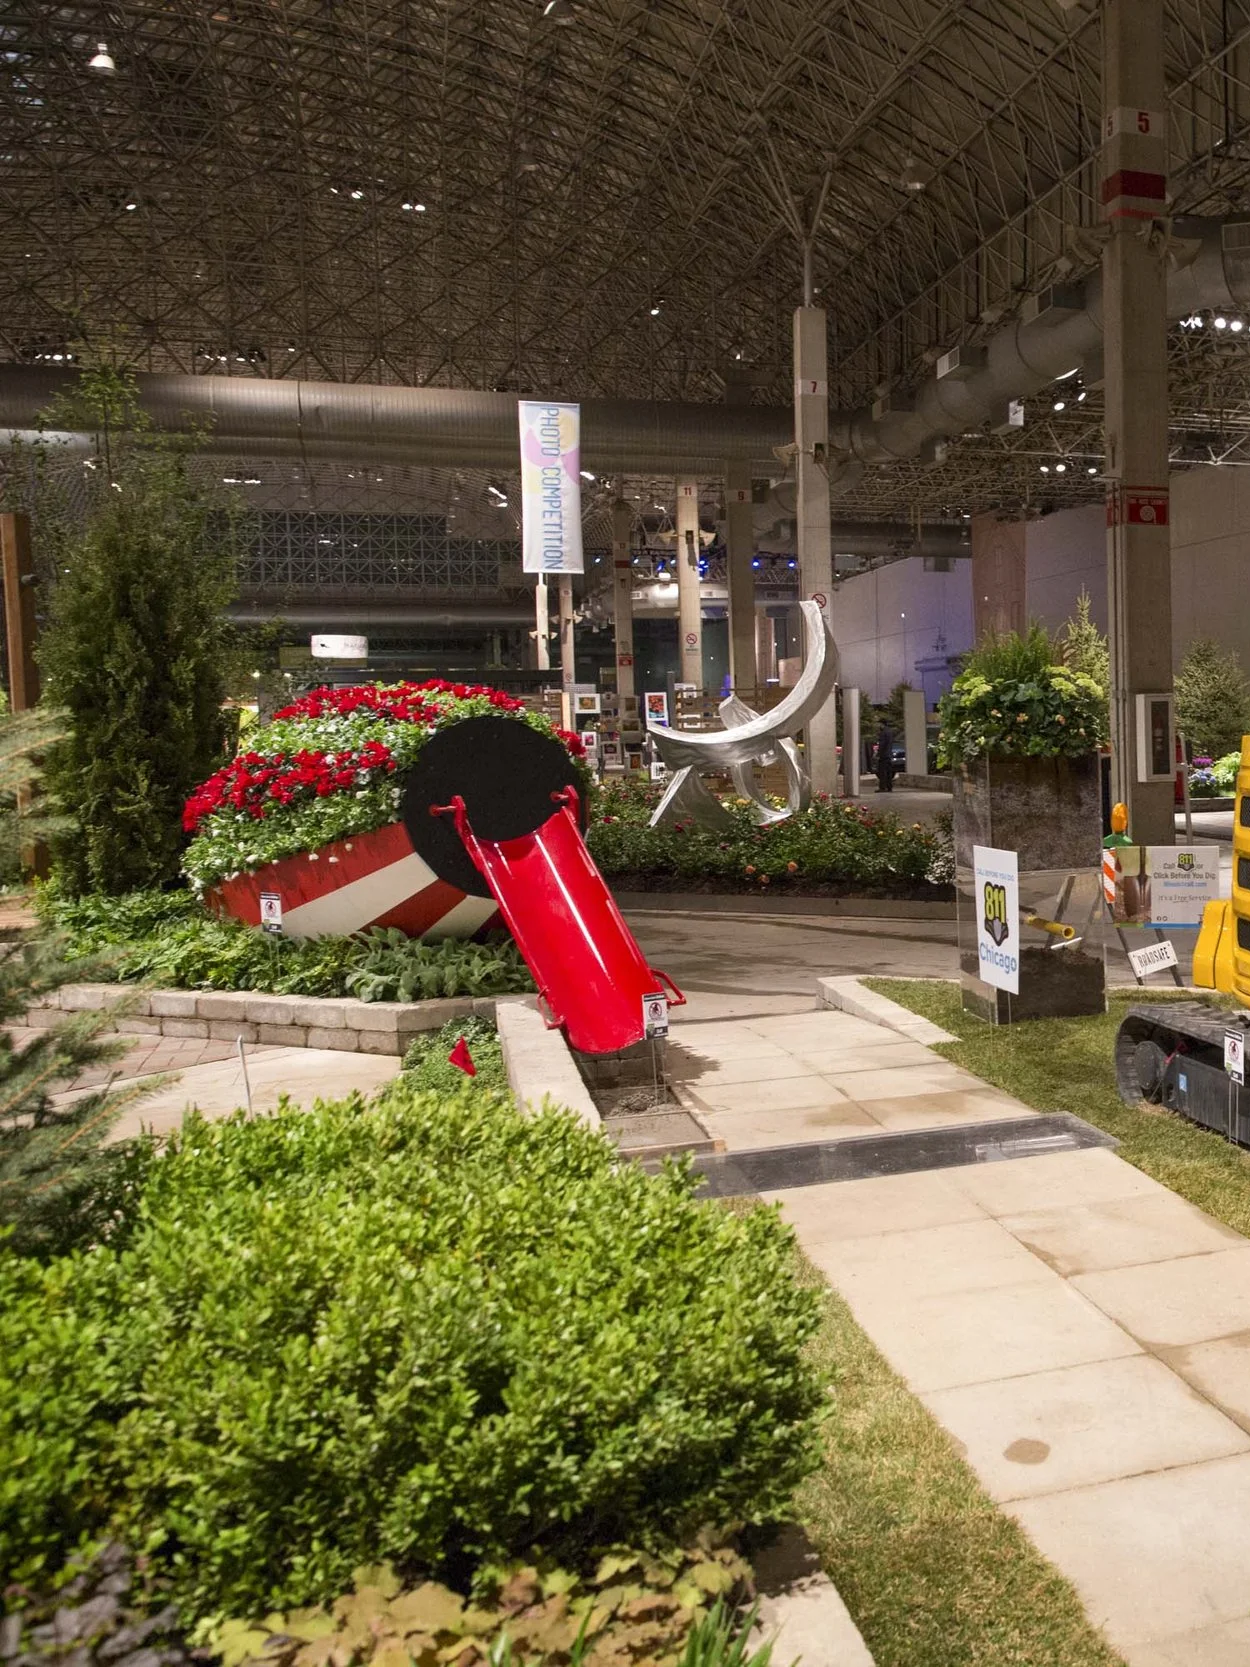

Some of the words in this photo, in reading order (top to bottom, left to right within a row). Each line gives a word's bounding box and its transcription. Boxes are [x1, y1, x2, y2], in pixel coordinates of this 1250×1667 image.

[1138, 112, 1149, 133] 5
[811, 381, 817, 393] 7
[540, 407, 560, 457] PHOTO
[684, 487, 692, 495] 11
[541, 467, 564, 570] COMPETITION
[1179, 854, 1193, 864] 811
[985, 883, 1006, 922] 811
[980, 942, 1017, 974] Chicago
